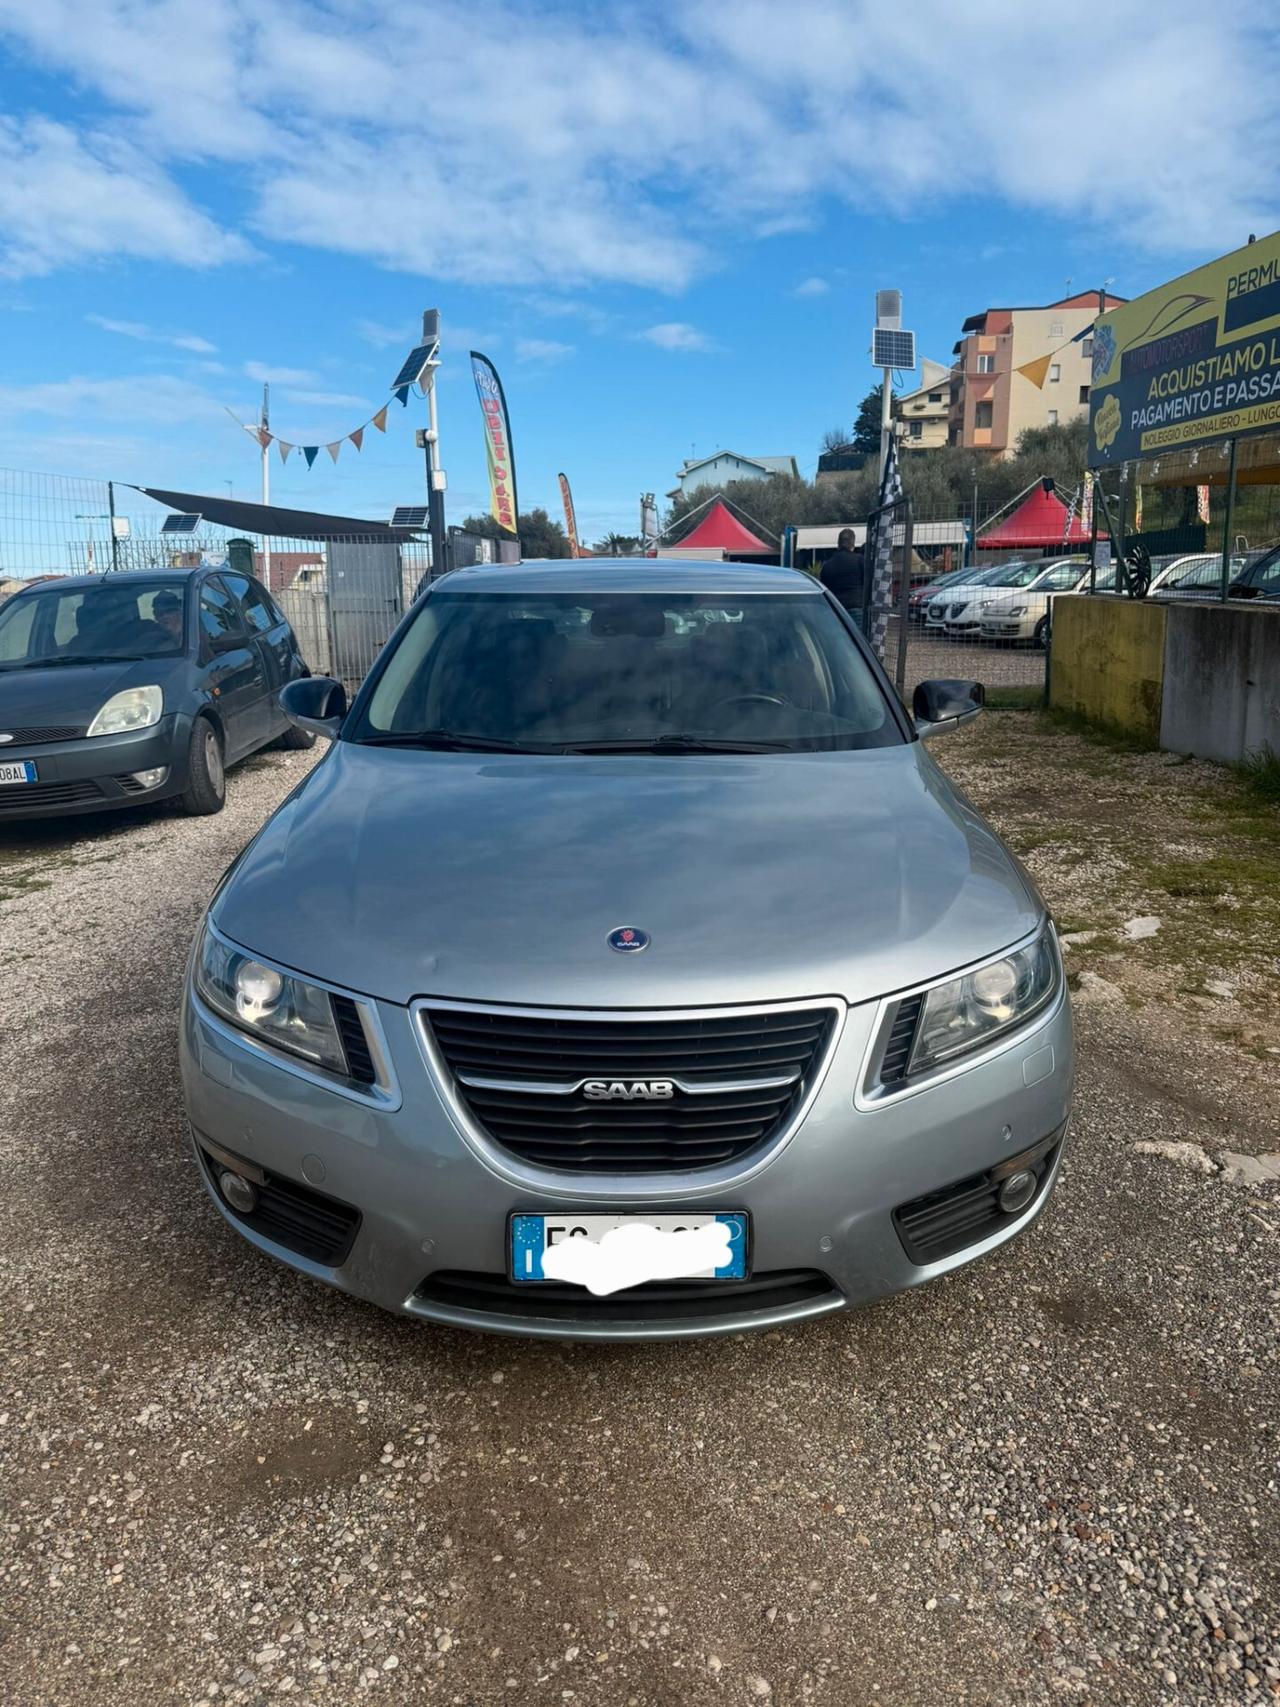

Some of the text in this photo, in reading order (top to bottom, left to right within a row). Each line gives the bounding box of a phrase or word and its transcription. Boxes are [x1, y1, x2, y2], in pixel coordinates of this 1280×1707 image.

[1148, 342, 1266, 401] ACQUISTIAMO
[1131, 390, 1211, 430] PAGAMENTO
[1213, 386, 1224, 409] E
[1144, 427, 1181, 447] NOLEGGIO
[1183, 414, 1240, 438] GIORNALIERO
[583, 1081, 674, 1101] SAAB
